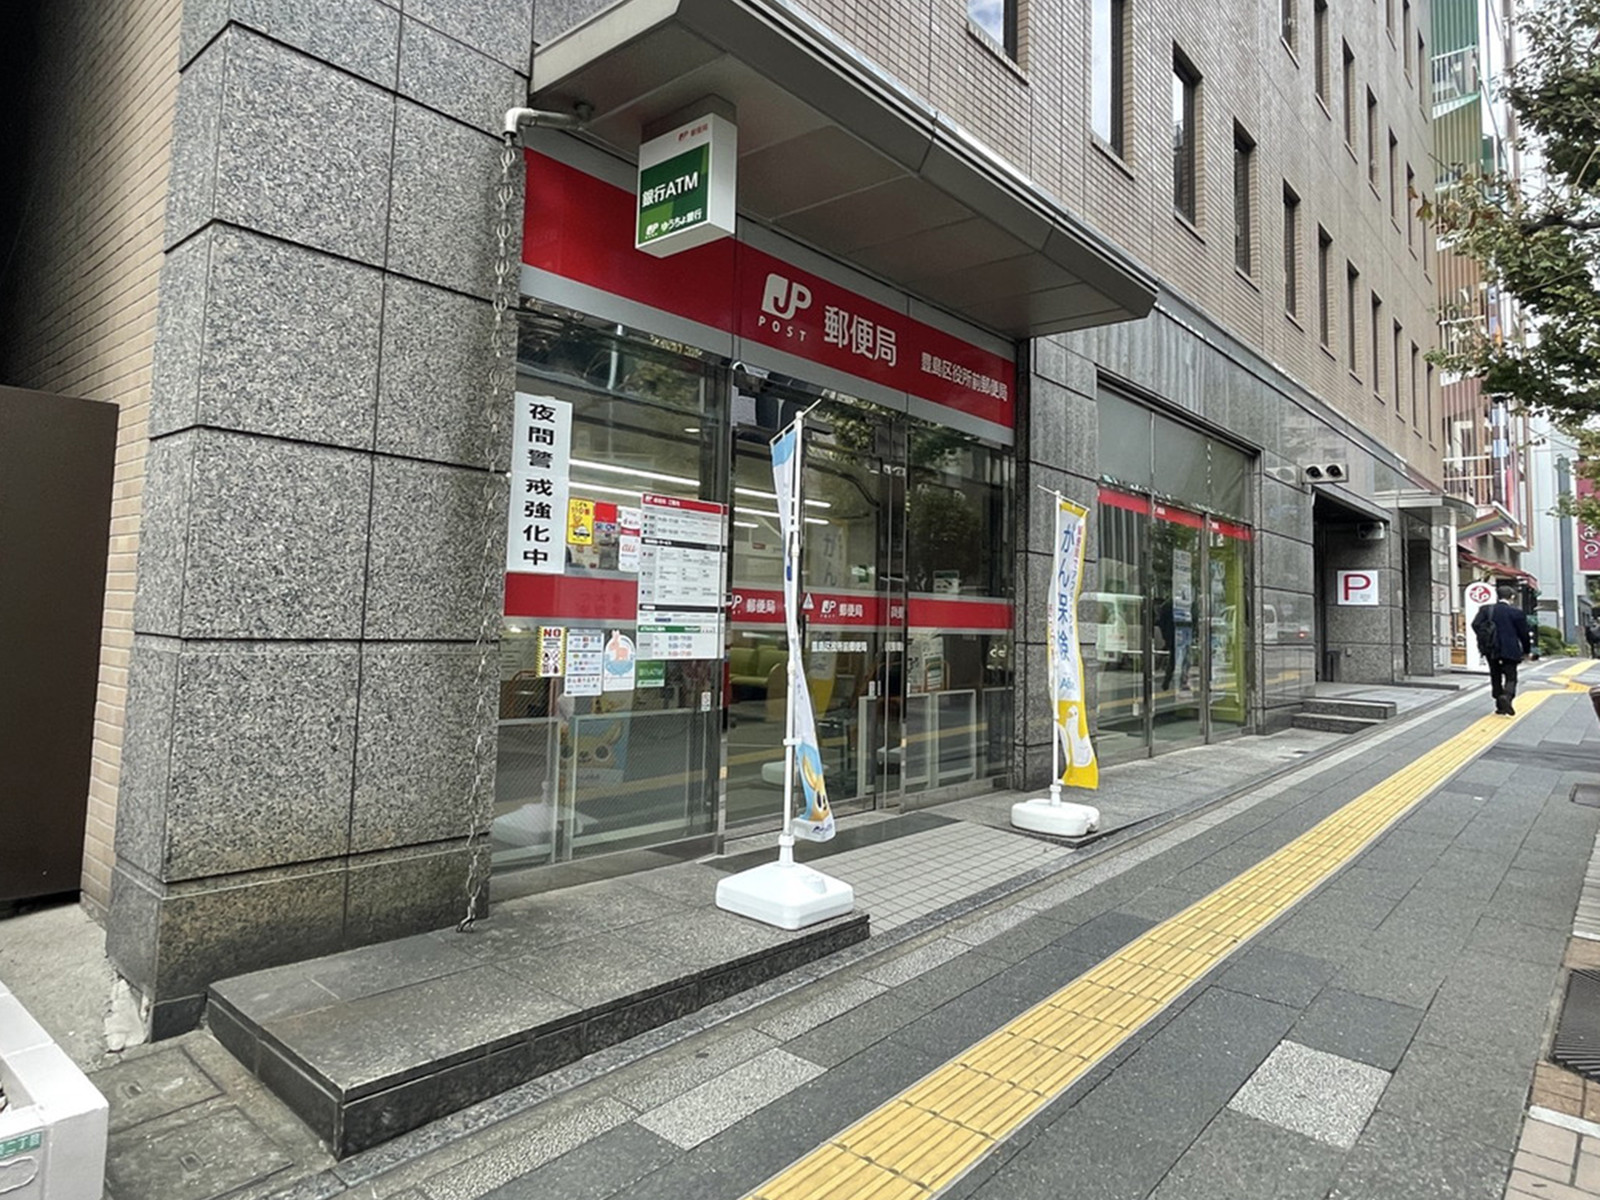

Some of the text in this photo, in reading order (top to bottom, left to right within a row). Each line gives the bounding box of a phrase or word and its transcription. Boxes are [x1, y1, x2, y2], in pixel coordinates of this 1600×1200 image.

[642, 171, 699, 207] 銀行ATM
[660, 208, 702, 232] ゆうちょ銀行
[758, 315, 807, 342] POST
[824, 305, 897, 367] 郵便局
[523, 403, 556, 566] 夜間警戒強化中
[1343, 574, 1371, 601] P
[746, 598, 776, 614] 郵便局
[839, 603, 863, 618] 郵便局
[543, 628, 561, 638] NO
